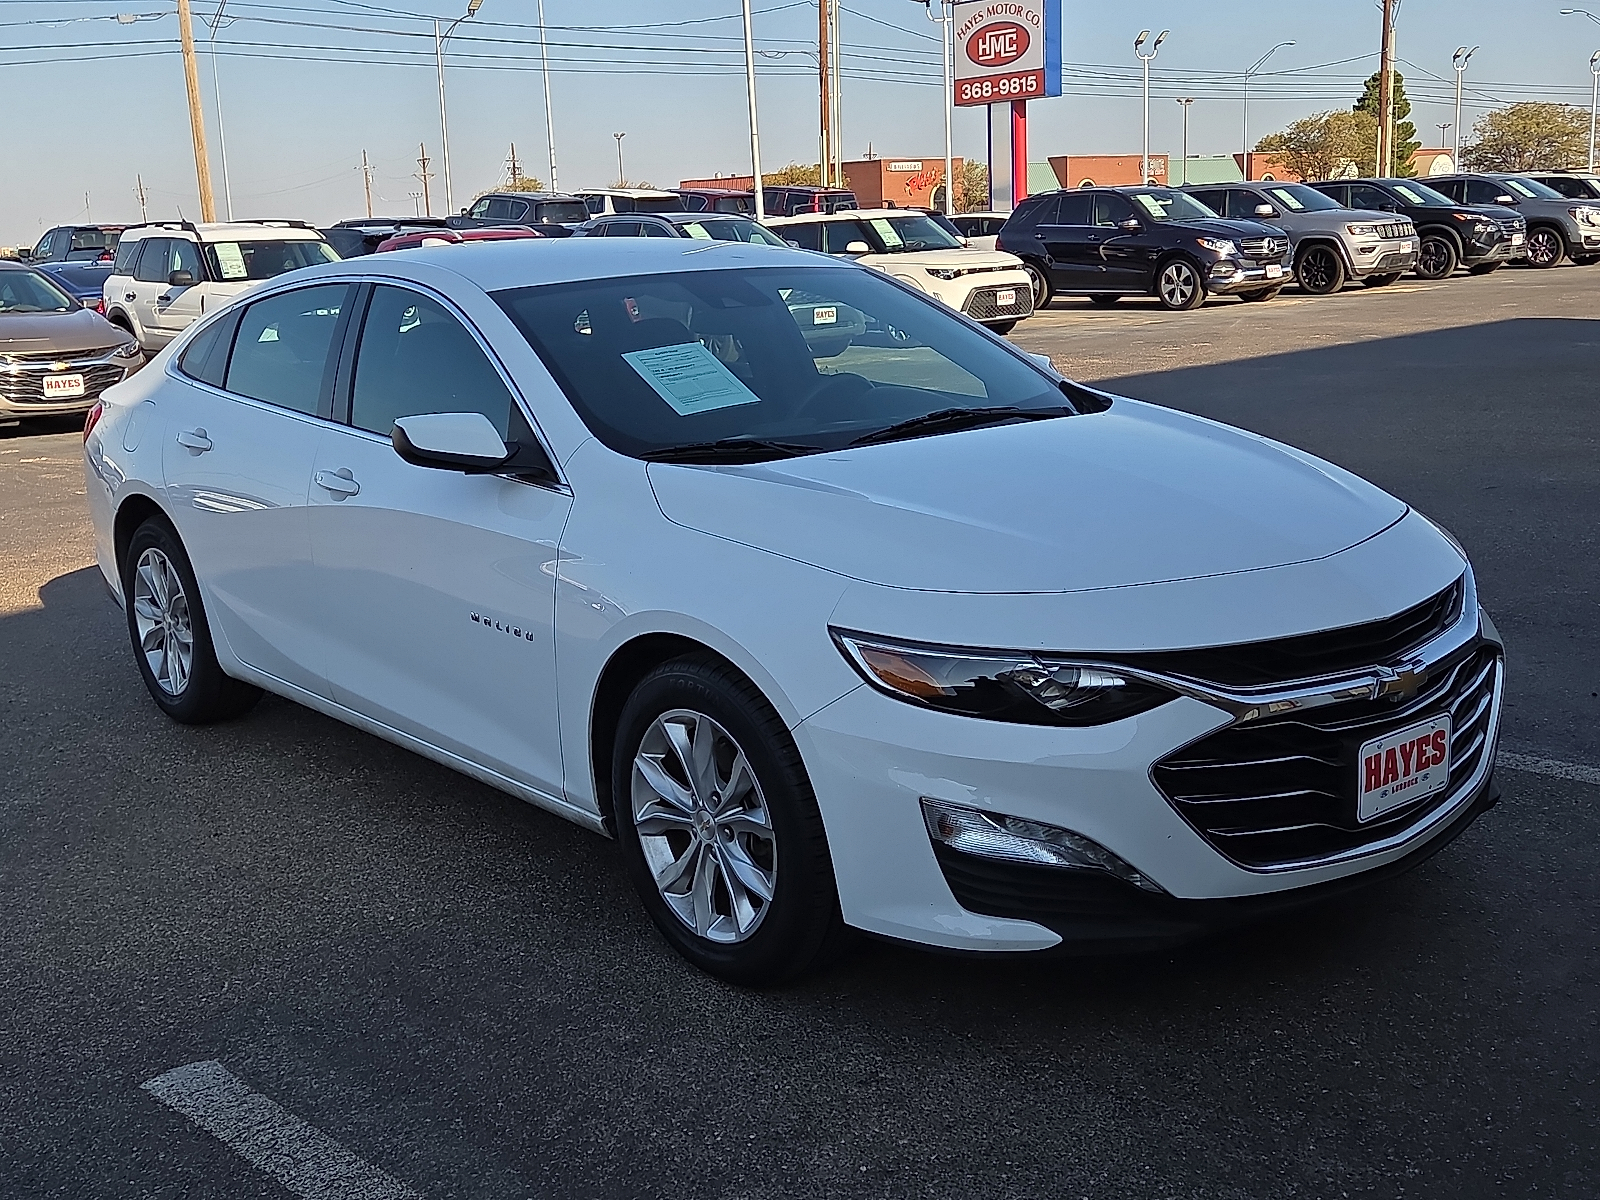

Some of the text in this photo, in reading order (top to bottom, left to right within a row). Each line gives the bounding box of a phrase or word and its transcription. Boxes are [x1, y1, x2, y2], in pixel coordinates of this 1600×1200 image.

[956, 3, 1040, 41] HAYES MOTOR CO.
[978, 27, 1017, 60] HMC
[961, 75, 1037, 100] 368-9815
[815, 310, 835, 318] HAYES
[45, 378, 80, 390] HAYES
[469, 610, 534, 642] MALIBU
[1364, 729, 1446, 794] HAYES
